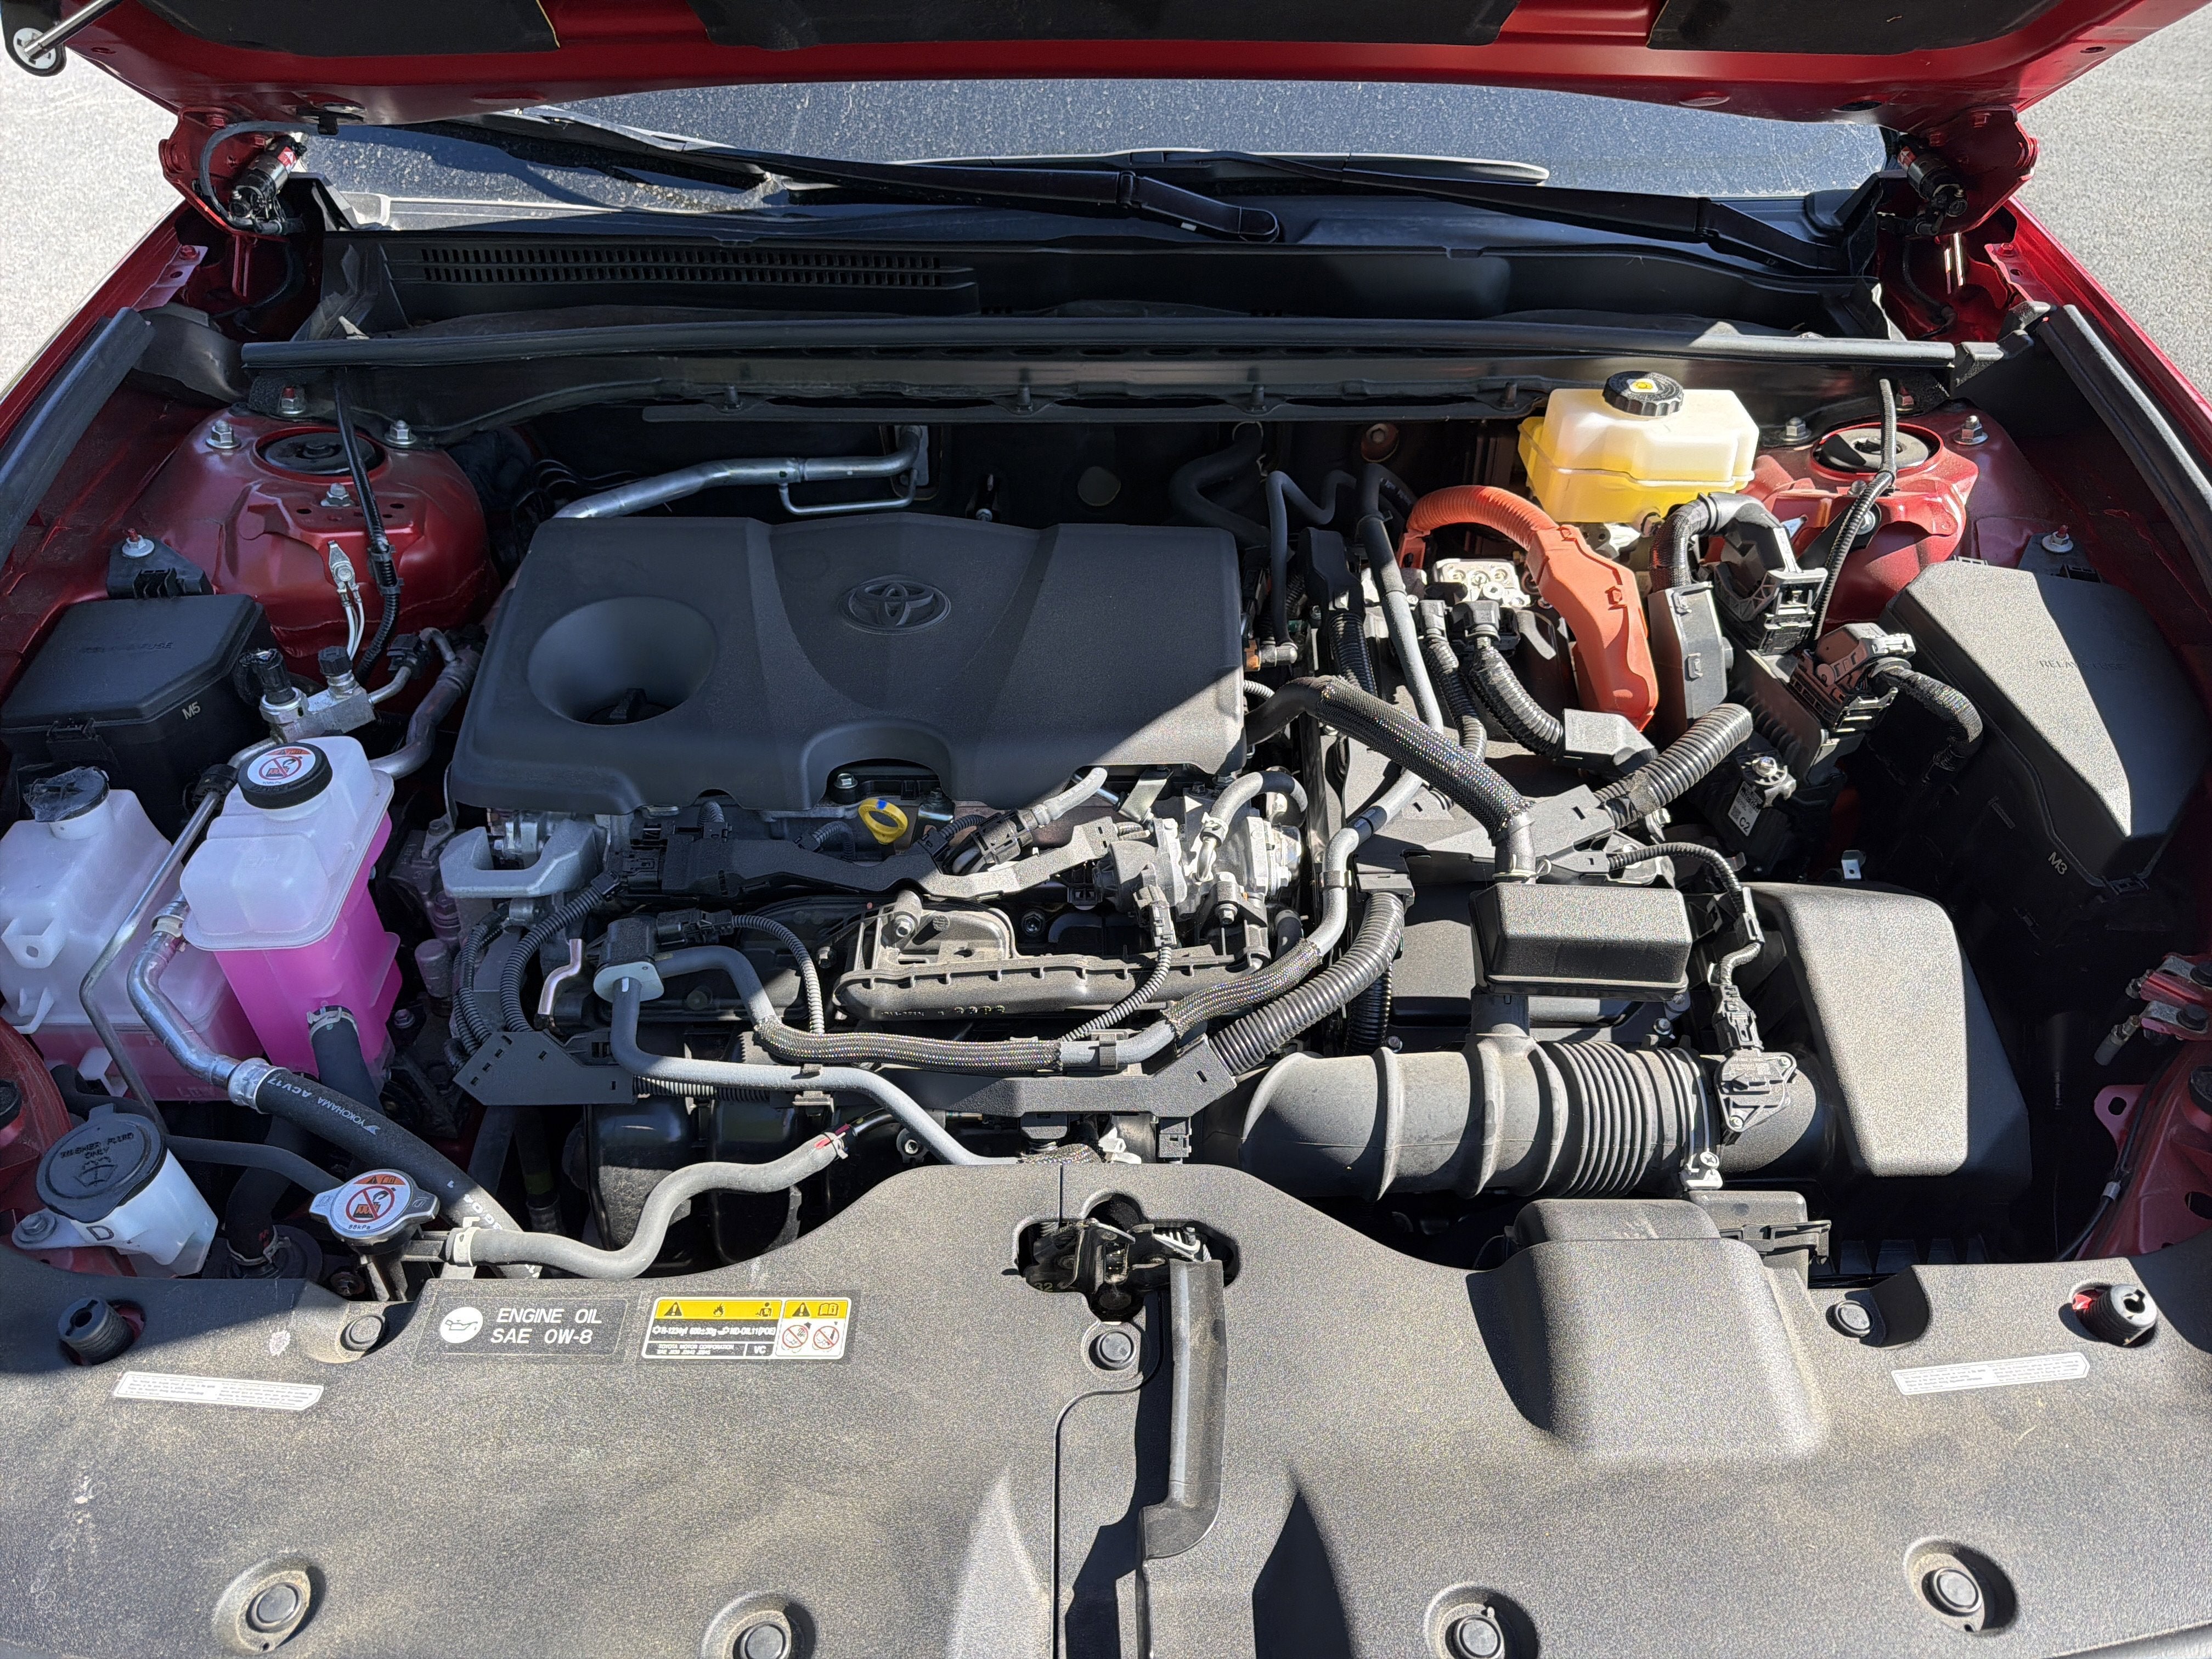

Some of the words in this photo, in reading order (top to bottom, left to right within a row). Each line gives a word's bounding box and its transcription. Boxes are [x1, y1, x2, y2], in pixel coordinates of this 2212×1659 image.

[182, 701, 201, 720] M5
[1739, 816, 1750, 833] C2
[2048, 851, 2068, 874] M3
[267, 1078, 312, 1098] ACV17
[317, 1097, 366, 1127] YOKOHAMA
[86, 1225, 114, 1242] D
[496, 1308, 565, 1323] ENGINE
[574, 1308, 602, 1324] OIL
[490, 1328, 533, 1344] SAE
[544, 1328, 593, 1344] 0W-8
[754, 1346, 766, 1355] VC
